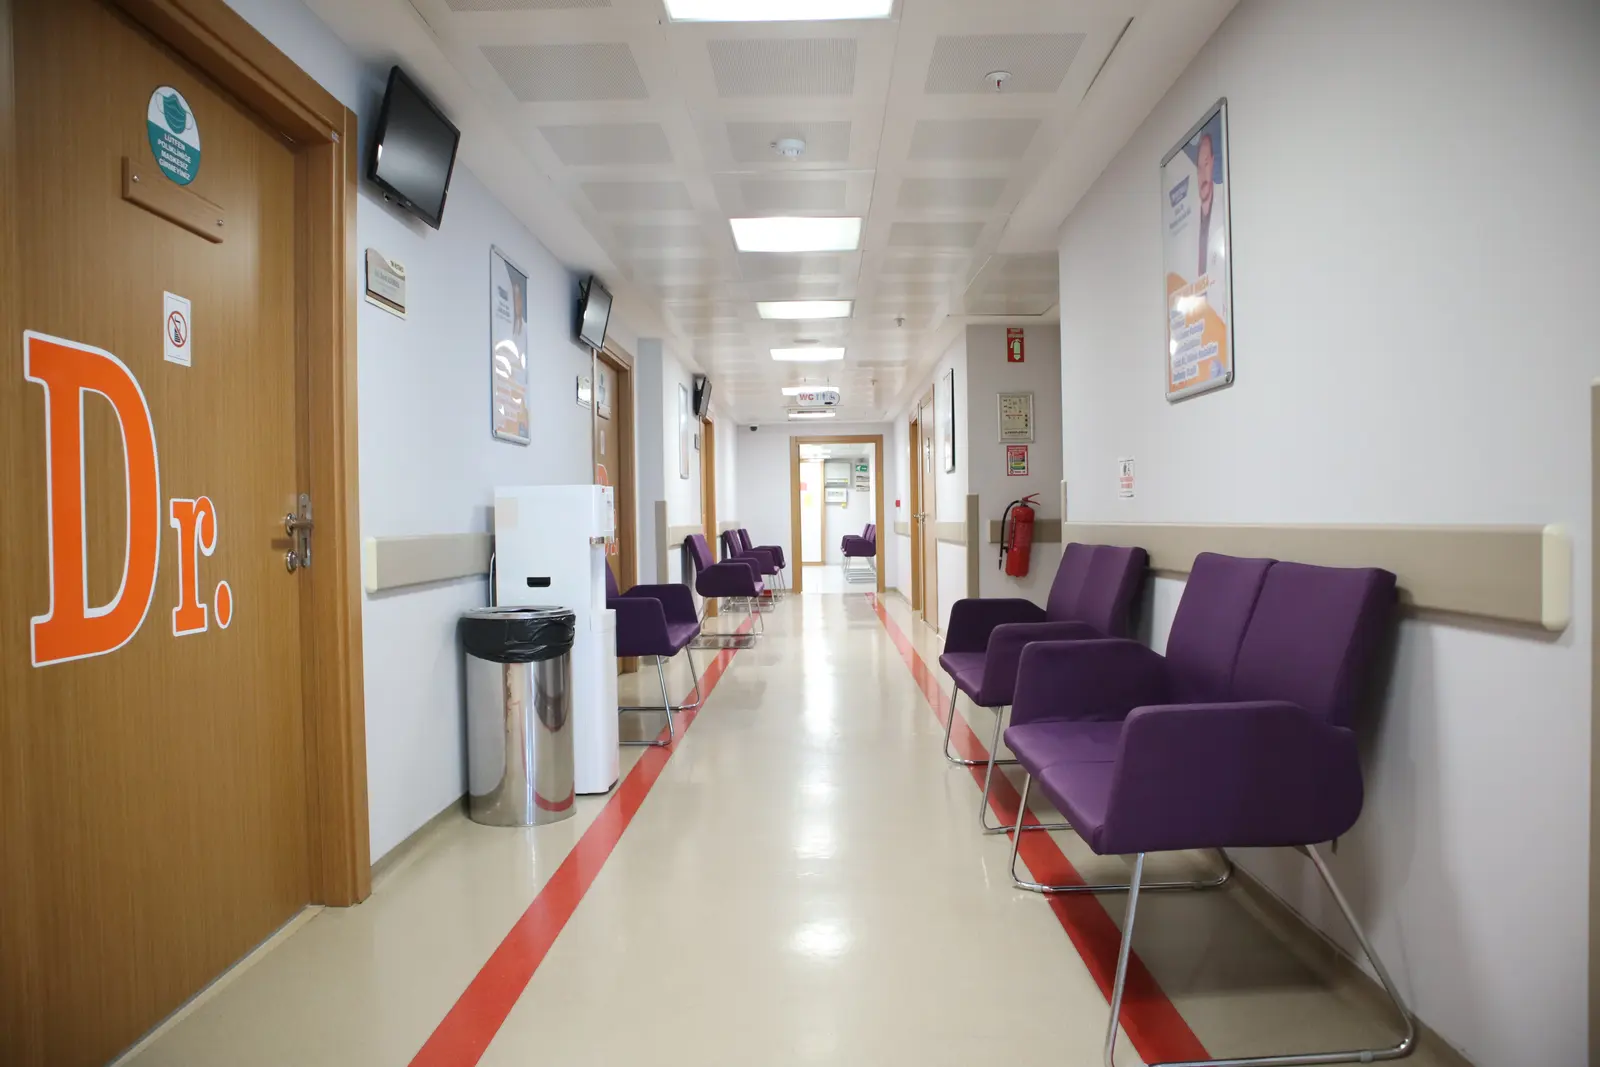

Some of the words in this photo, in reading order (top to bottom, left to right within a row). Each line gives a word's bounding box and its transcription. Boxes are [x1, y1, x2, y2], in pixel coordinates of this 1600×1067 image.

[164, 133, 186, 151] LÜTFEN
[800, 393, 814, 401] WC
[23, 329, 233, 667] Dr.
